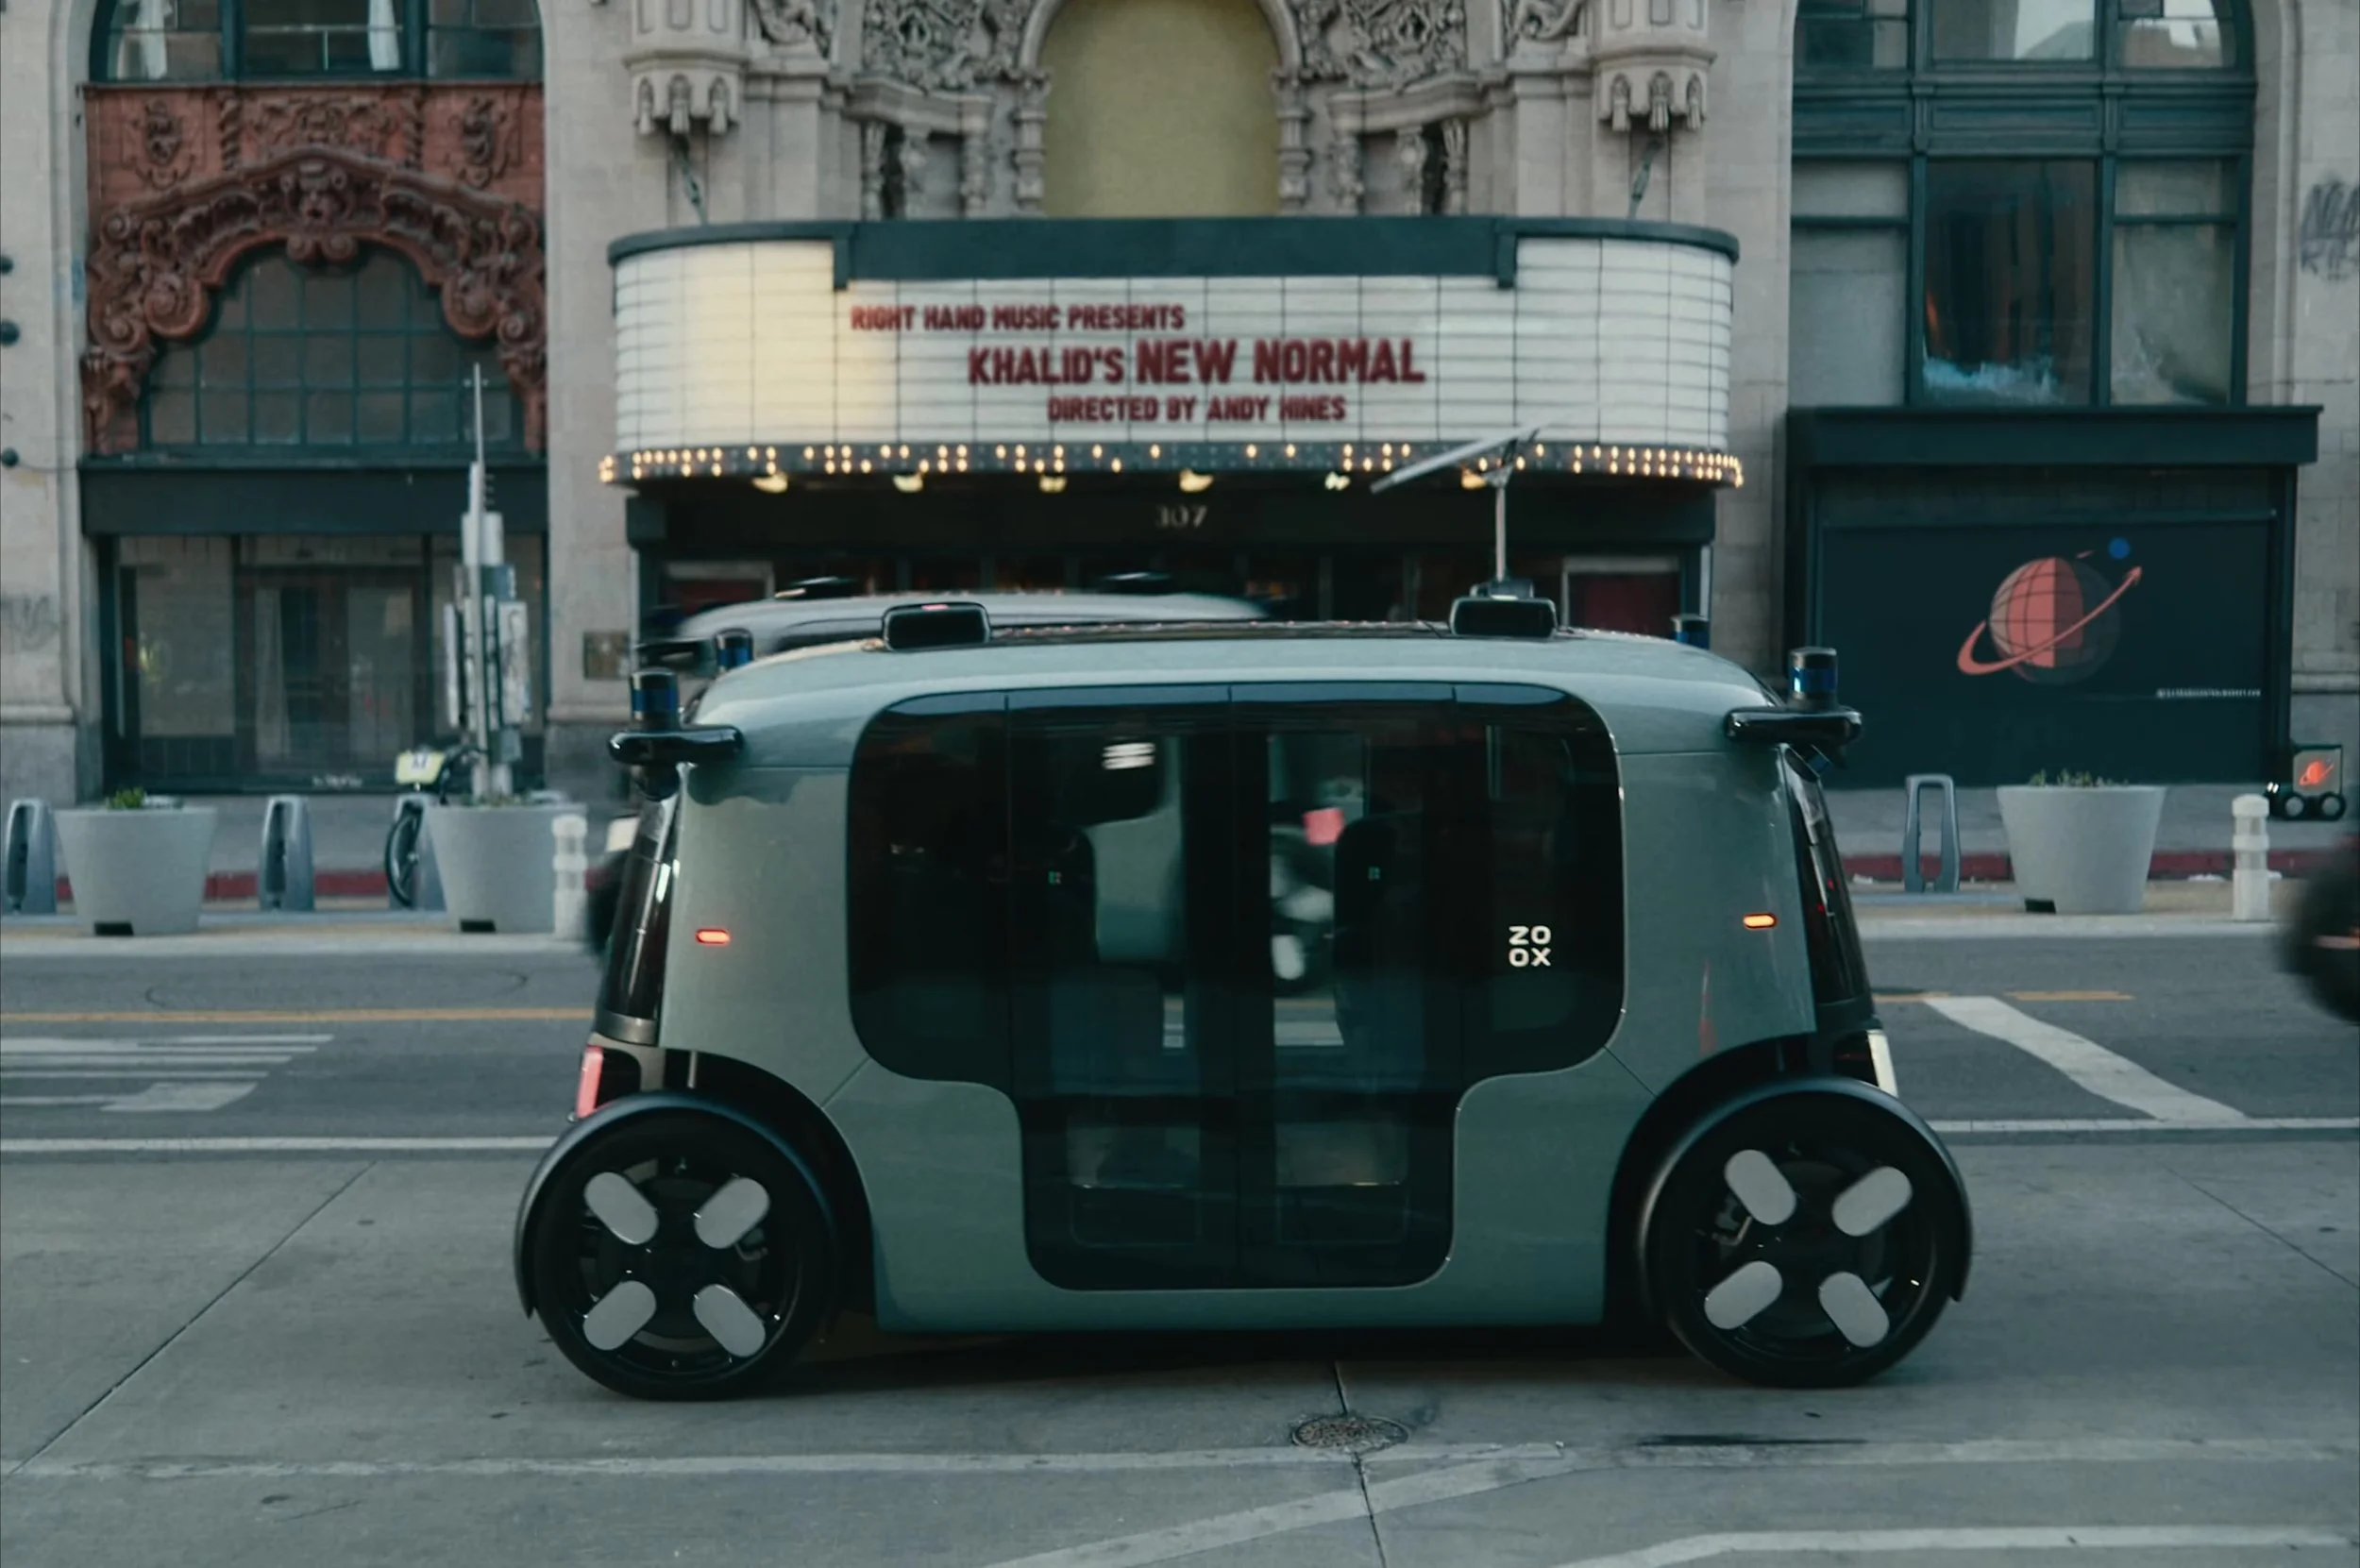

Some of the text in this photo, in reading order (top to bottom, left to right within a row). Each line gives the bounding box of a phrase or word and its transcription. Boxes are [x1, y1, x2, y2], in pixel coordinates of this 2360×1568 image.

[851, 305, 1185, 330] RIGHT HAND MUSIC PRESENTS
[968, 338, 1426, 385] KHALID'S NEW NORMAL
[1047, 395, 1346, 422] DIRECTED BY ANDY HINES
